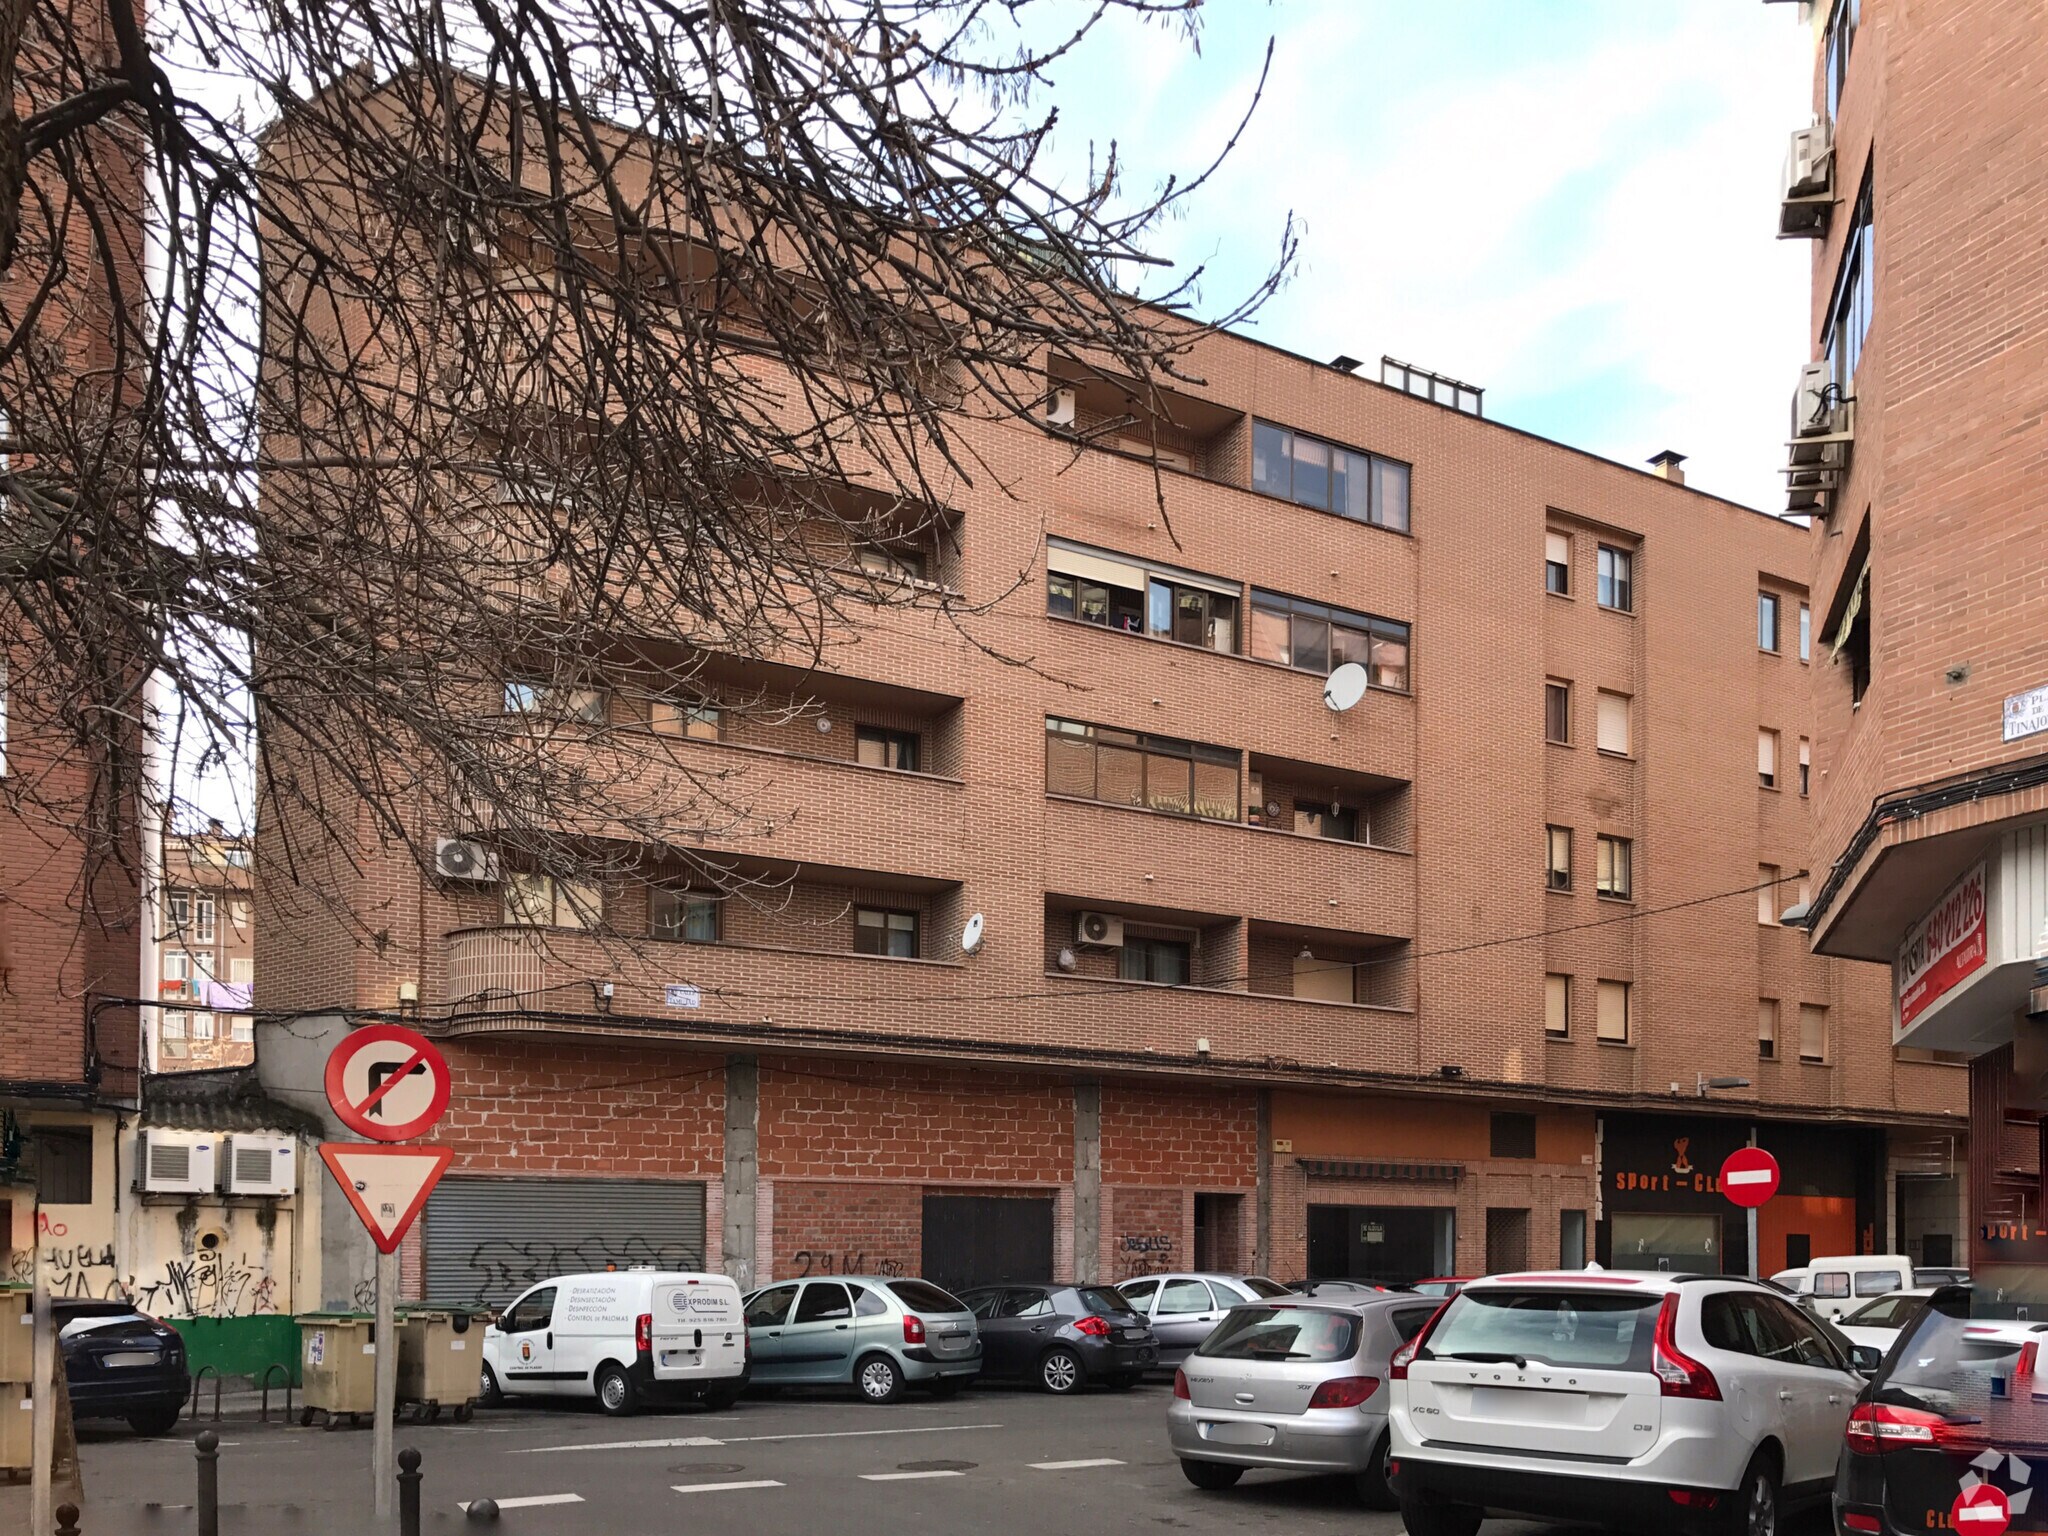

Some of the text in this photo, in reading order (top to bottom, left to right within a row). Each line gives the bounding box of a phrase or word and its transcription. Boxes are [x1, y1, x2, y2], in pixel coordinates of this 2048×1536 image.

[2010, 715, 2048, 736] TINAJO
[683, 1298, 718, 1306] EXPRODIM
[1469, 1372, 1578, 1385] VOLVO
